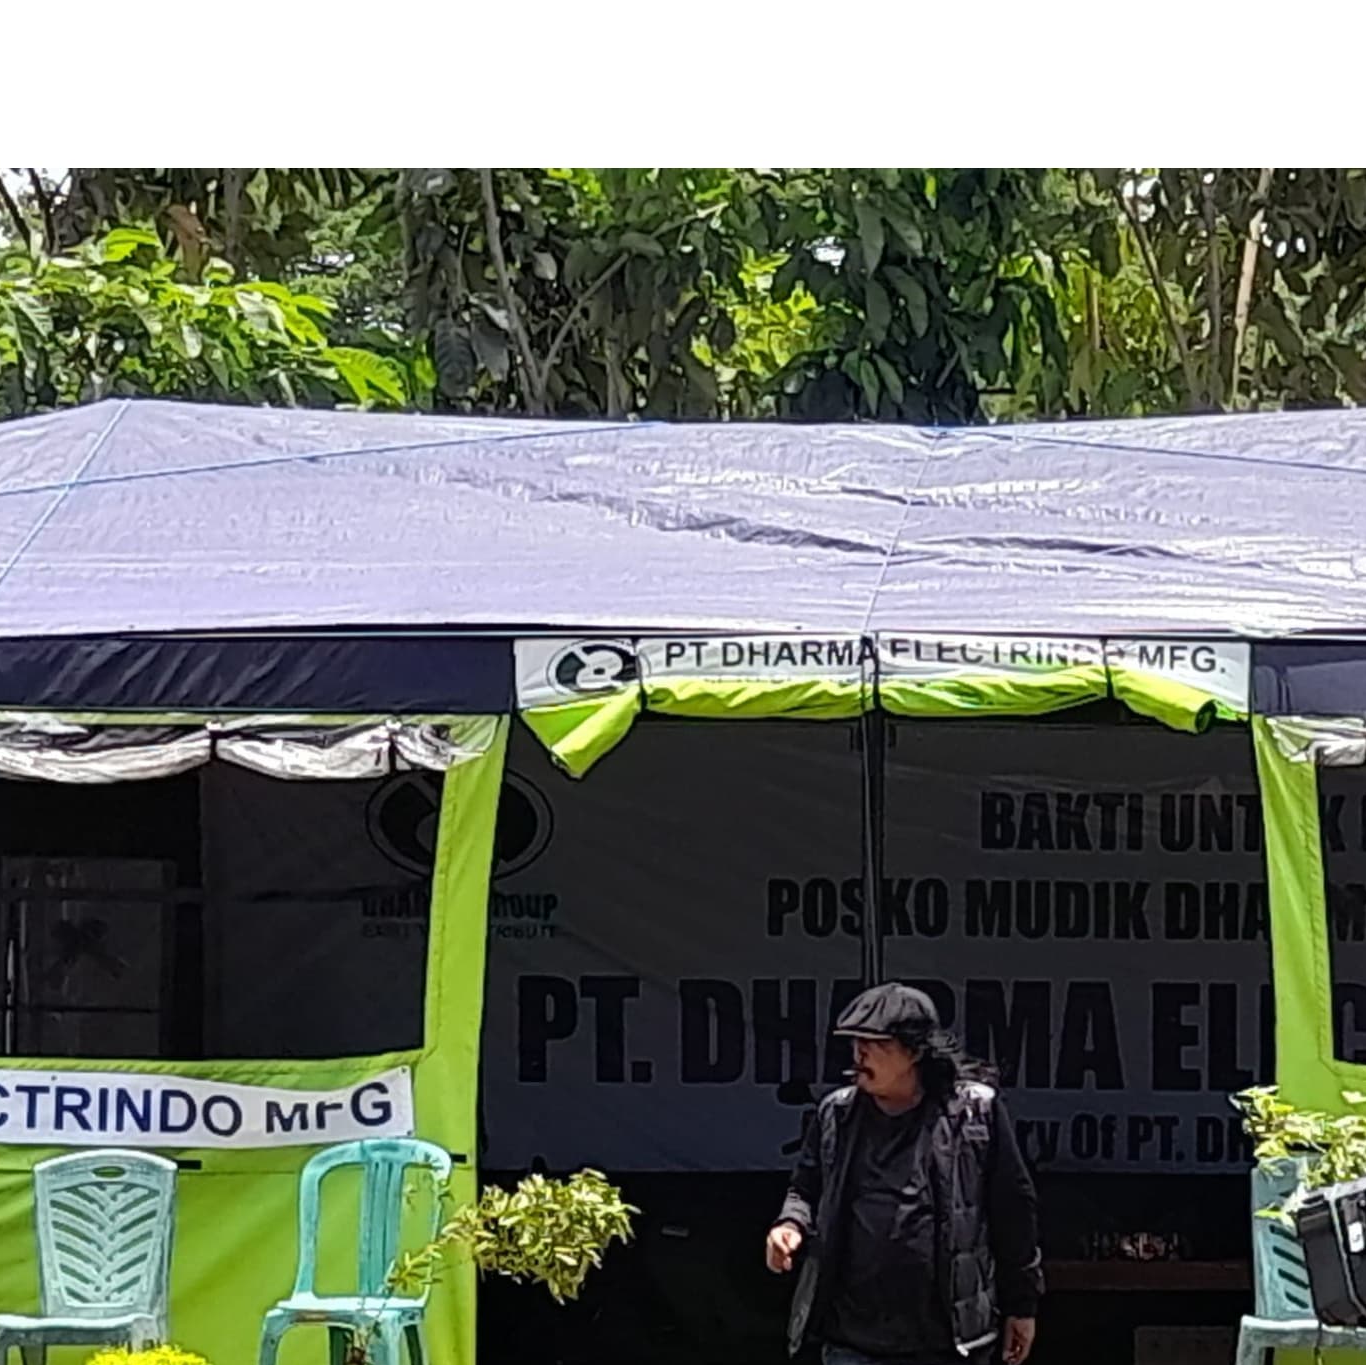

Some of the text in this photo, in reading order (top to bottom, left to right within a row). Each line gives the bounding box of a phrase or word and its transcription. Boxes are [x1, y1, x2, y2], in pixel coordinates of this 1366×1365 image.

[665, 641, 708, 667] PT
[721, 638, 878, 667] DHARMA
[980, 791, 1144, 851] BAKTI
[1159, 793, 1346, 852] UNTK
[766, 878, 949, 937] POSKO
[964, 880, 1150, 939] MUDIK
[518, 975, 652, 1084] PT.
[678, 978, 1125, 1090] DHMA
